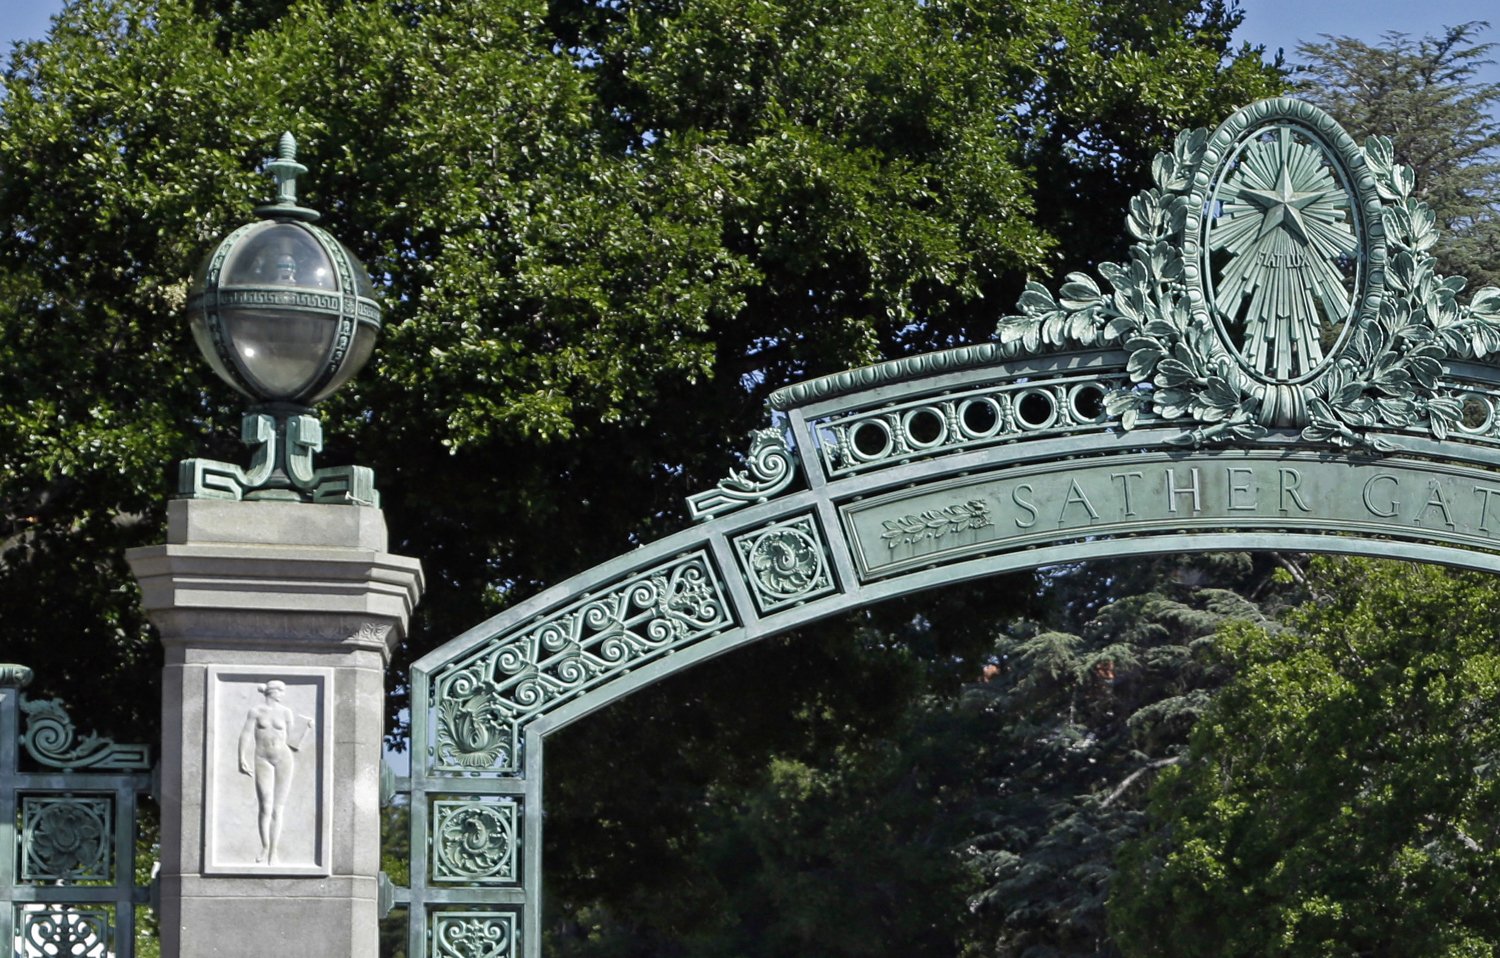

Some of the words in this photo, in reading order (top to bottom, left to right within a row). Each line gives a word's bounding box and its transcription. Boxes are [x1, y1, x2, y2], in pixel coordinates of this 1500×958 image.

[1257, 250, 1282, 269] FIAT
[1284, 252, 1310, 269] LUX
[1011, 467, 1313, 529] SATHER
